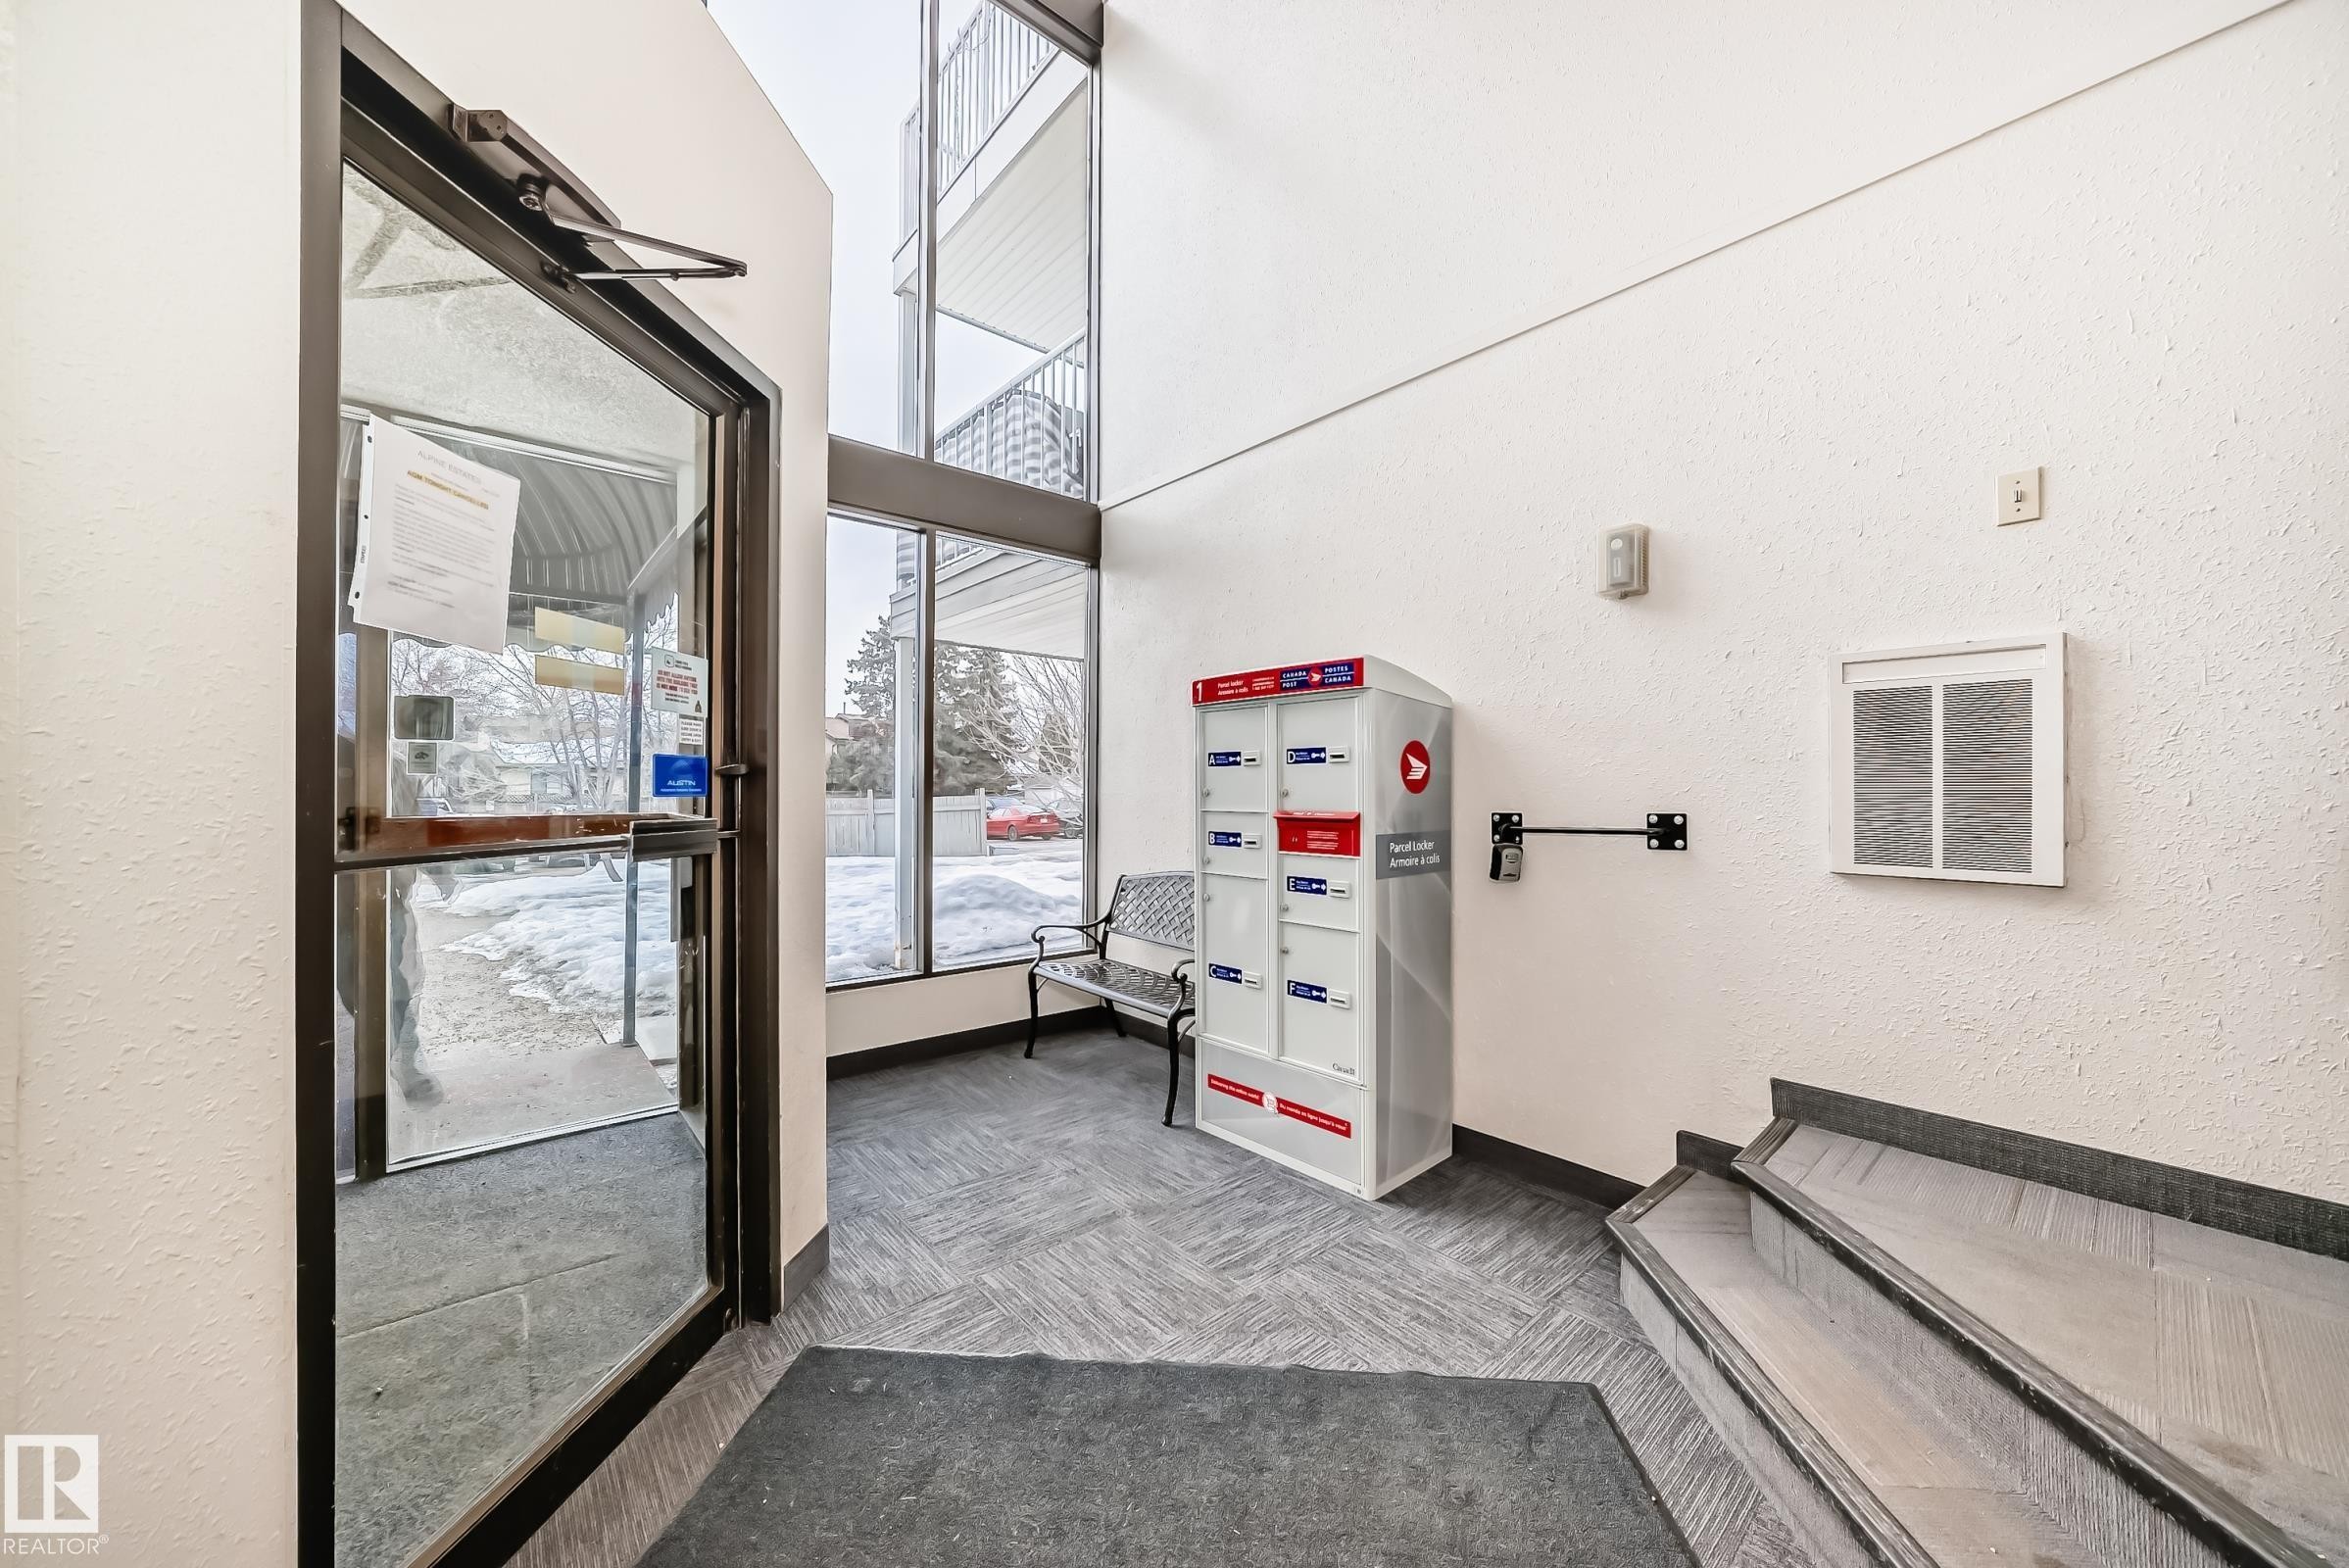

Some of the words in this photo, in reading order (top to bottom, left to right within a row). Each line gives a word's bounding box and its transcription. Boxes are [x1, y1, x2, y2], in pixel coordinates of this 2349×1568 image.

[407, 469, 422, 481] AGM
[1282, 670, 1306, 679] CANADA
[1325, 665, 1348, 674] POSTES
[1325, 675, 1351, 684] CANADA
[1196, 682, 1202, 702] 1
[1208, 754, 1216, 765] A
[1287, 751, 1296, 763] D
[1209, 833, 1216, 845] B
[1390, 840, 1411, 854] Parcel
[1412, 839, 1435, 852] Locker
[1390, 856, 1419, 868] Armoire
[1420, 854, 1425, 865] à
[1426, 852, 1441, 864] colis
[1289, 878, 1296, 891] E
[1209, 965, 1217, 978] C
[1289, 982, 1297, 996] F
[1287, 1105, 1300, 1115] monde
[1307, 1112, 1318, 1121] ligne
